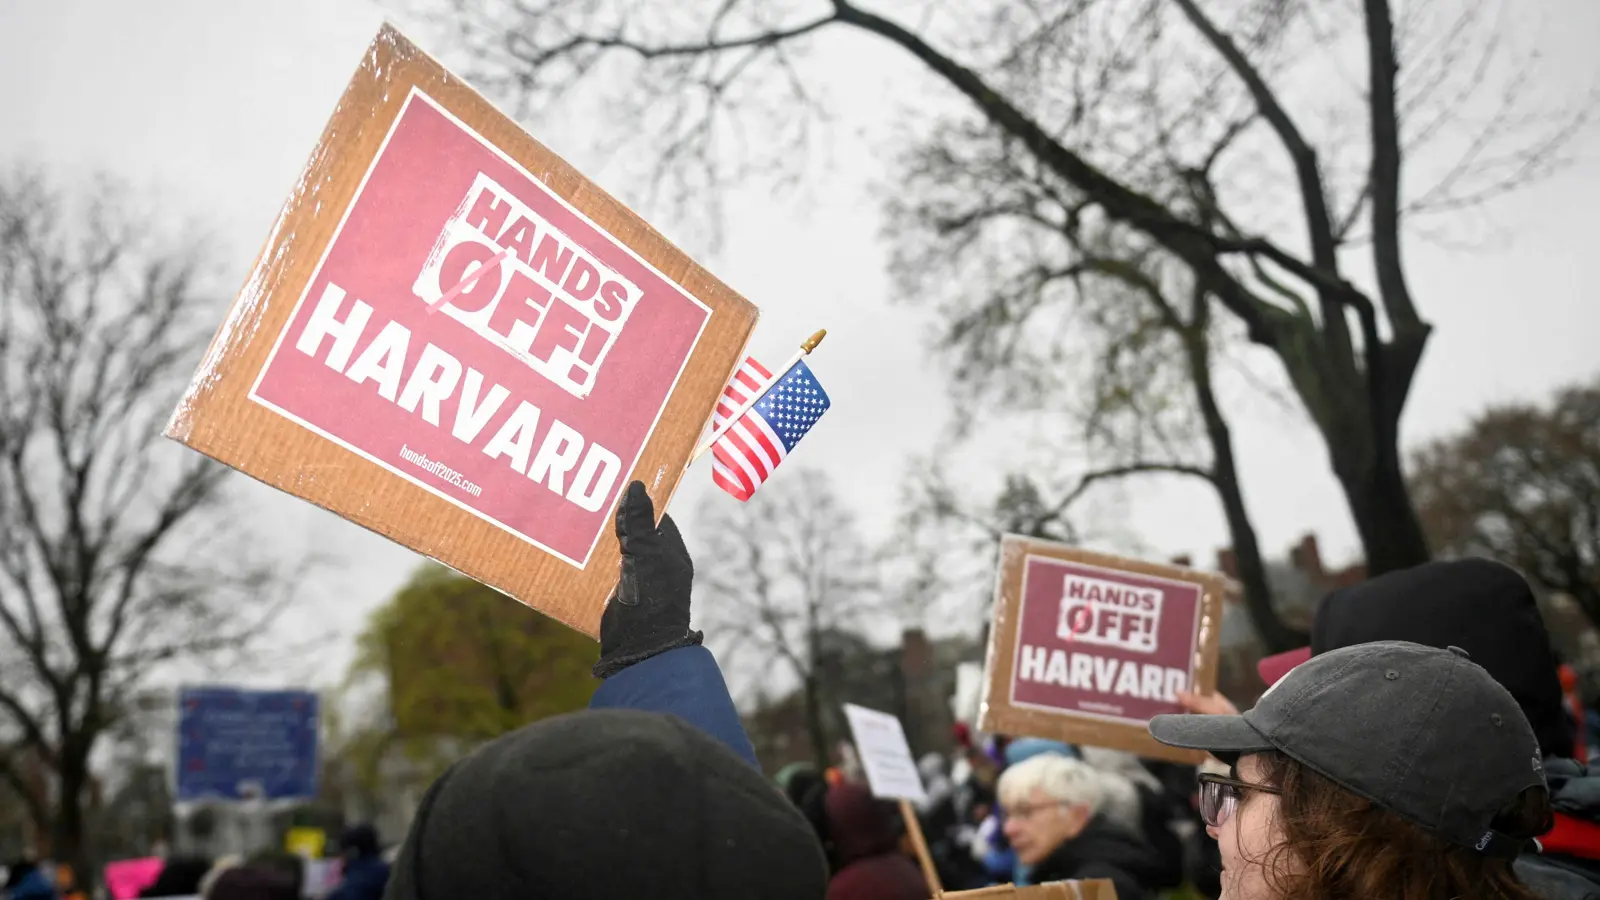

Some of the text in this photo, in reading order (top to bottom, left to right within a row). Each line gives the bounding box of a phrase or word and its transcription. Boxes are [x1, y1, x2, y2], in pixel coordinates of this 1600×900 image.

[465, 187, 628, 322] HANDS
[295, 282, 622, 513] HARVARD
[400, 443, 482, 497] handsoff2025.com
[1068, 580, 1156, 611] HANDS
[1018, 644, 1188, 703] HARVARD
